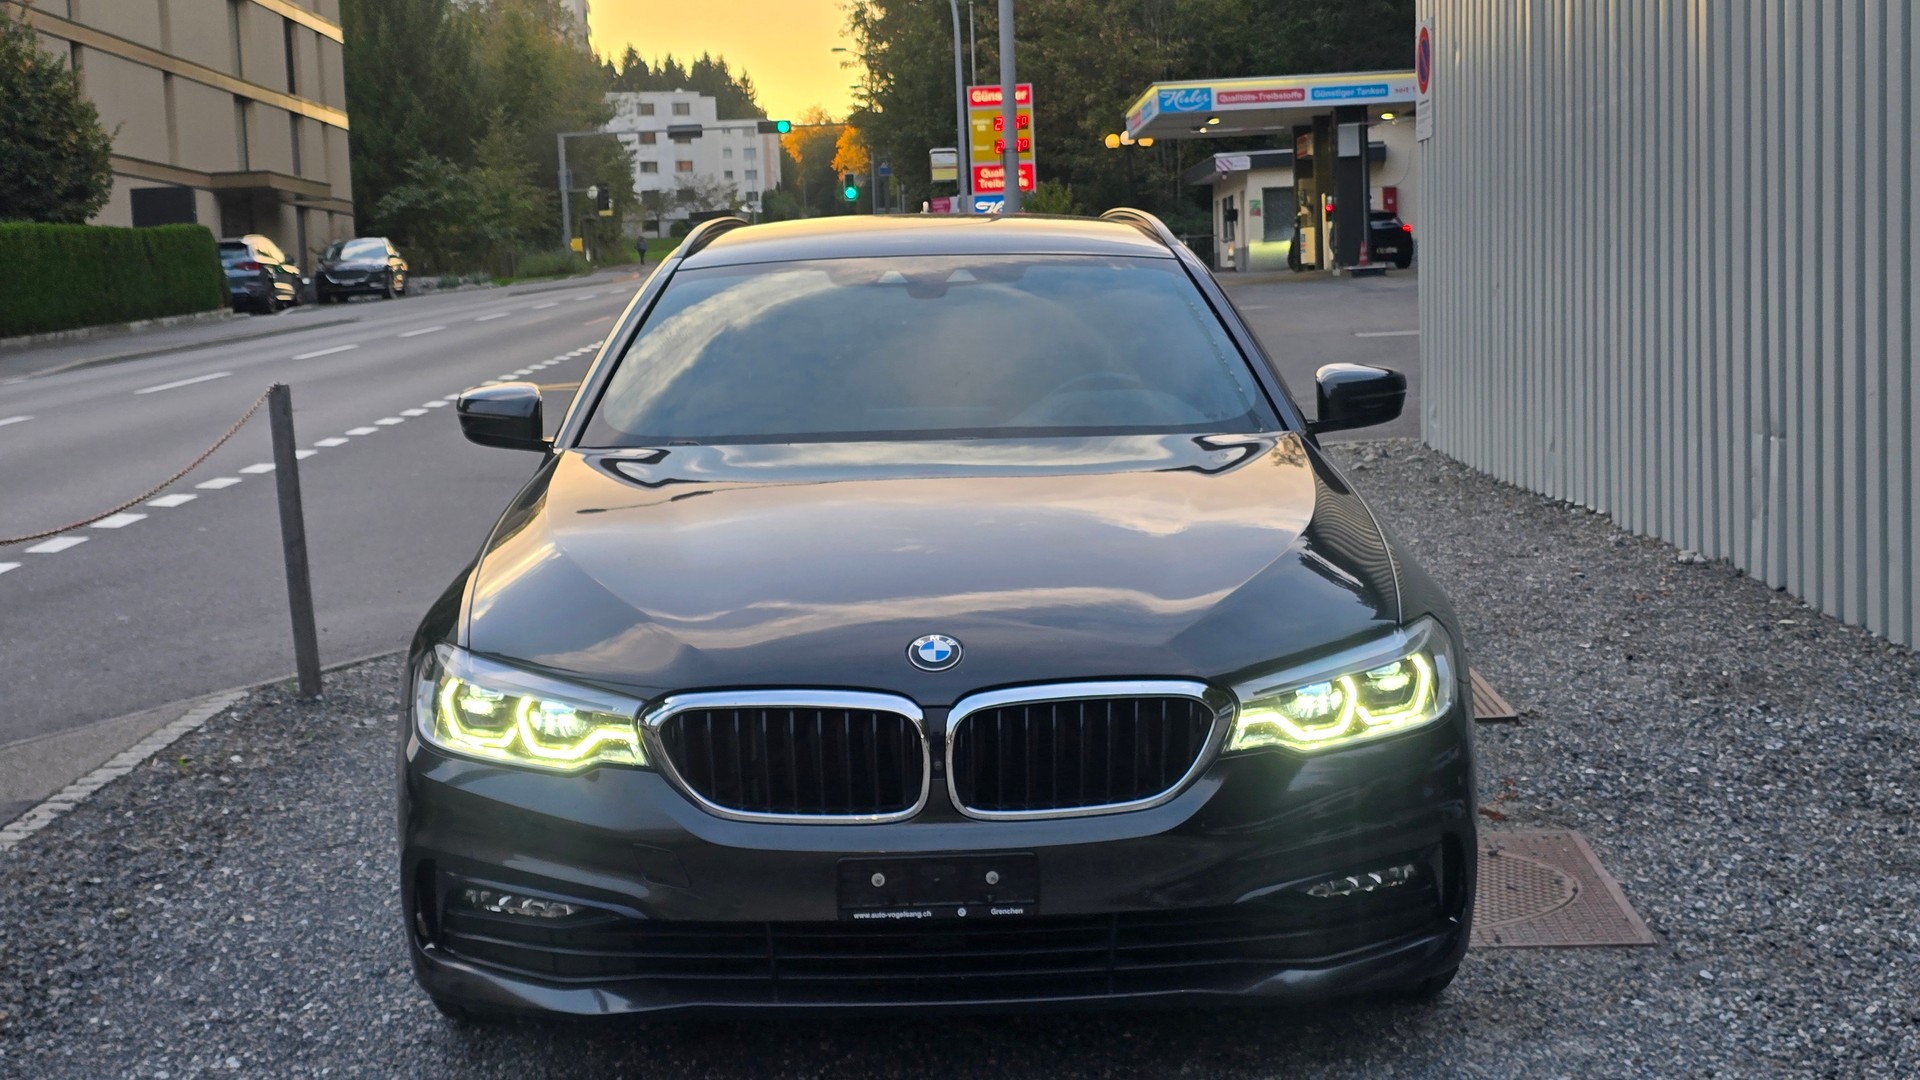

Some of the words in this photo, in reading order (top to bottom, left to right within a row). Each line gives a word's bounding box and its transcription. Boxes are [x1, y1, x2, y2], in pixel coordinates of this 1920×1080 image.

[972, 90, 1028, 103] Günser
[1357, 87, 1386, 96] Tanken
[914, 635, 957, 646] BMW
[853, 911, 932, 919] www.auto-vogelsang.ch
